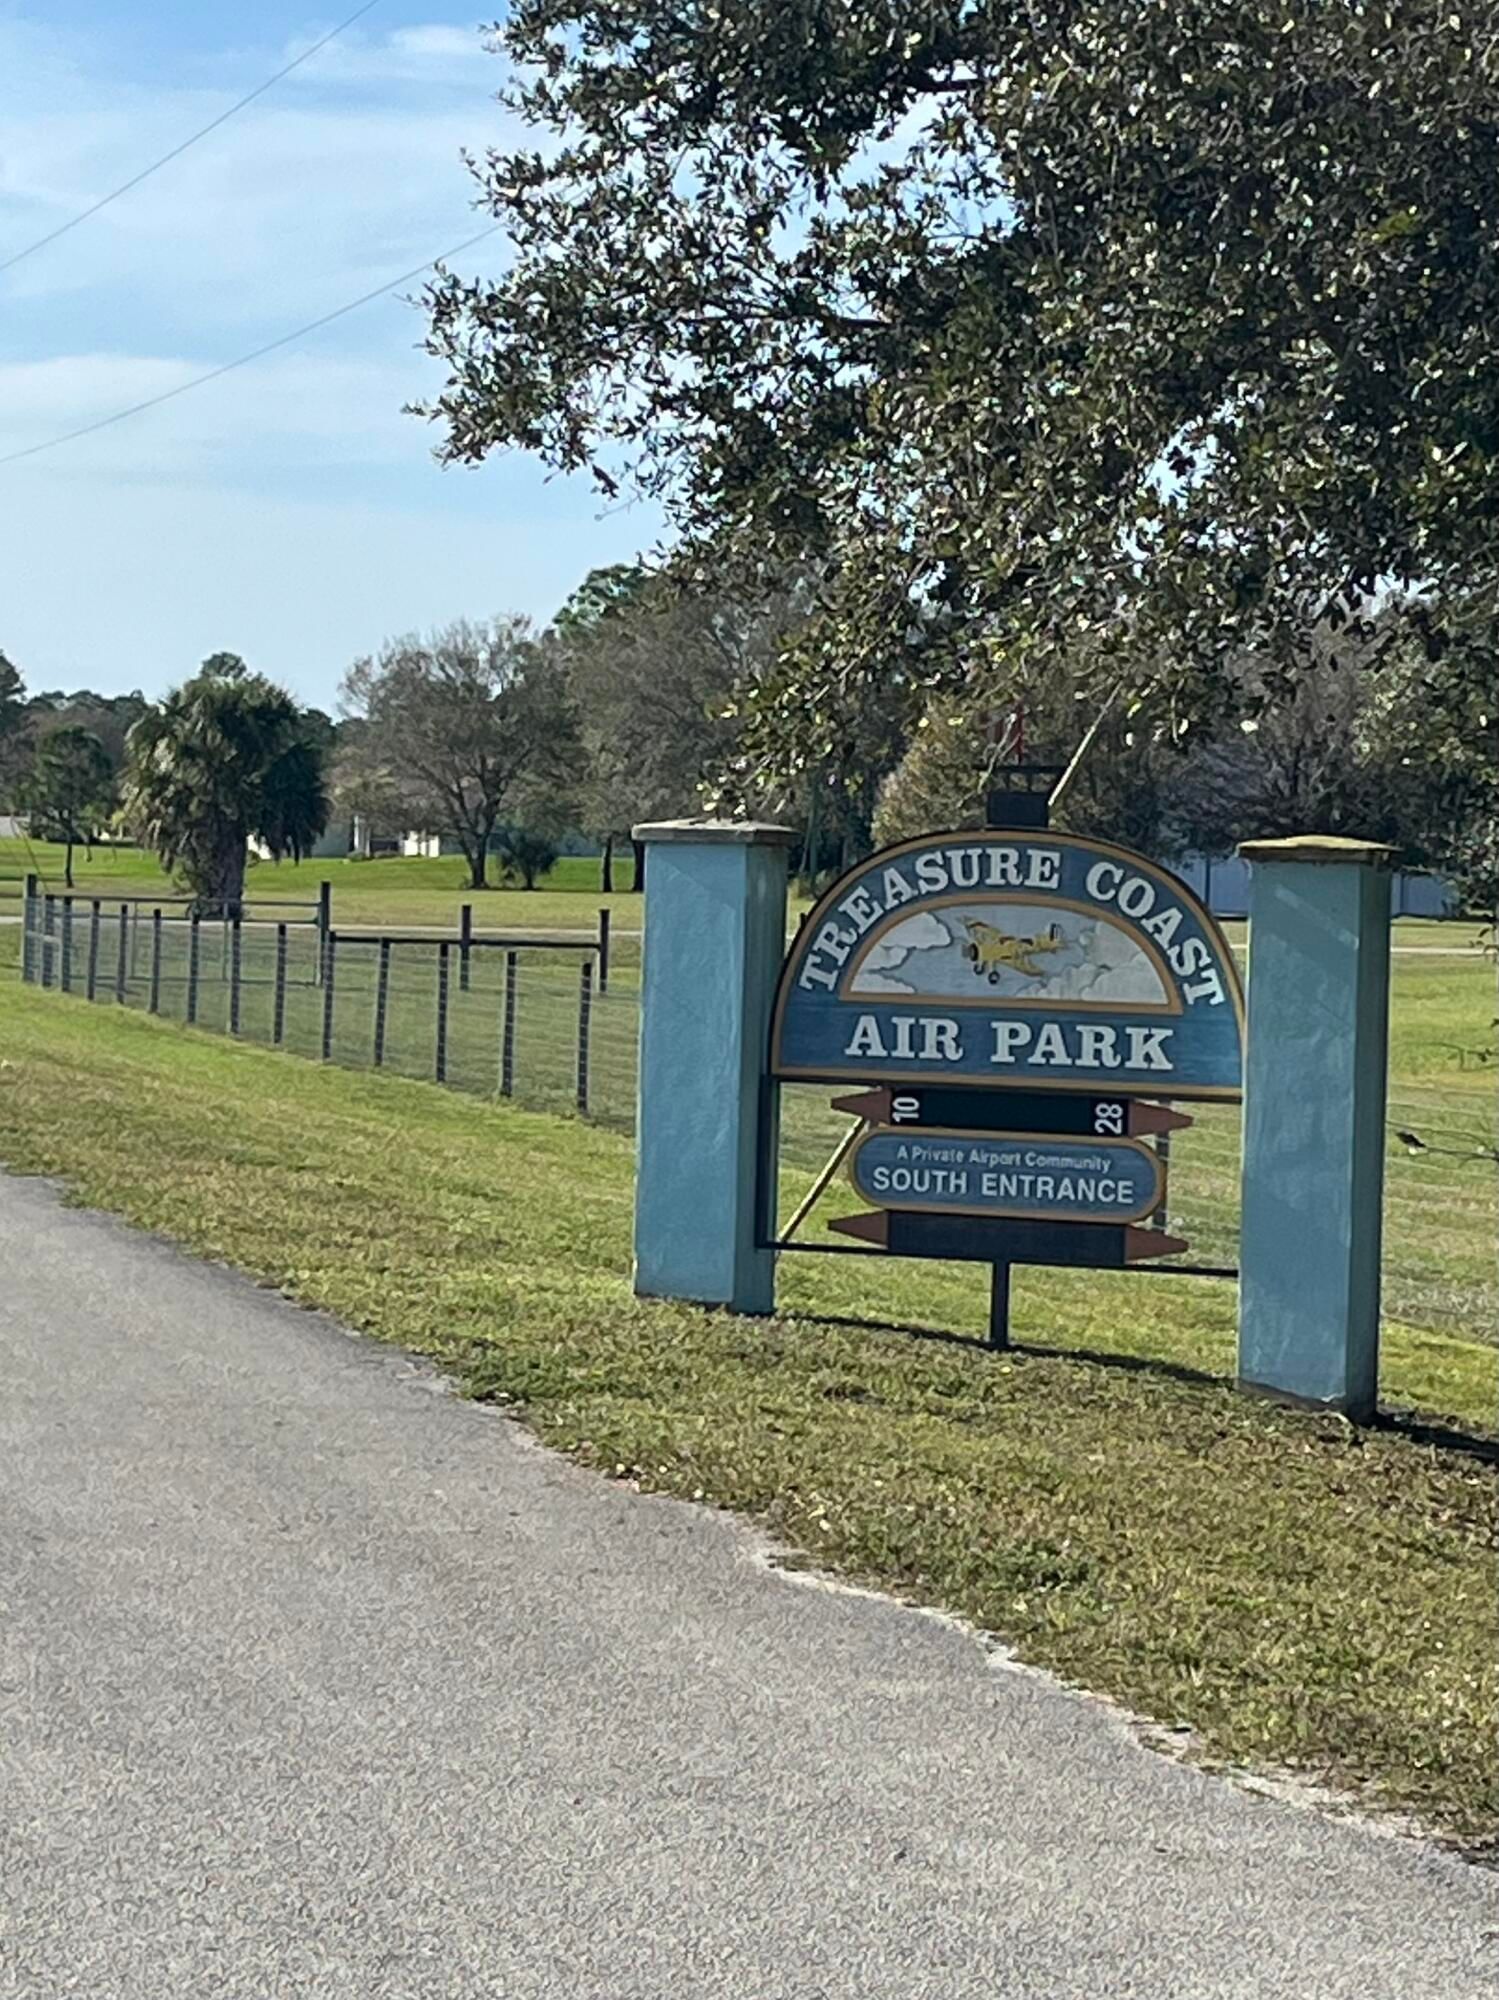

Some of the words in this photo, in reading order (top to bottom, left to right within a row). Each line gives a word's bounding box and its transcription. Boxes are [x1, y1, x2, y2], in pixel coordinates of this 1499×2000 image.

[800, 847, 1060, 992] TREASURE
[1085, 861, 1225, 1006] COAST
[845, 1015, 963, 1061] AIR
[990, 1021, 1174, 1071] PARK
[892, 1096, 920, 1122] 10
[1095, 1103, 1124, 1134] 28
[897, 1146, 908, 1159] A
[911, 1146, 964, 1164] Private
[969, 1149, 1021, 1168] Airport
[1025, 1152, 1111, 1175] Community
[872, 1166, 967, 1194] SOUTH
[981, 1173, 1134, 1204] ENTRANCE
